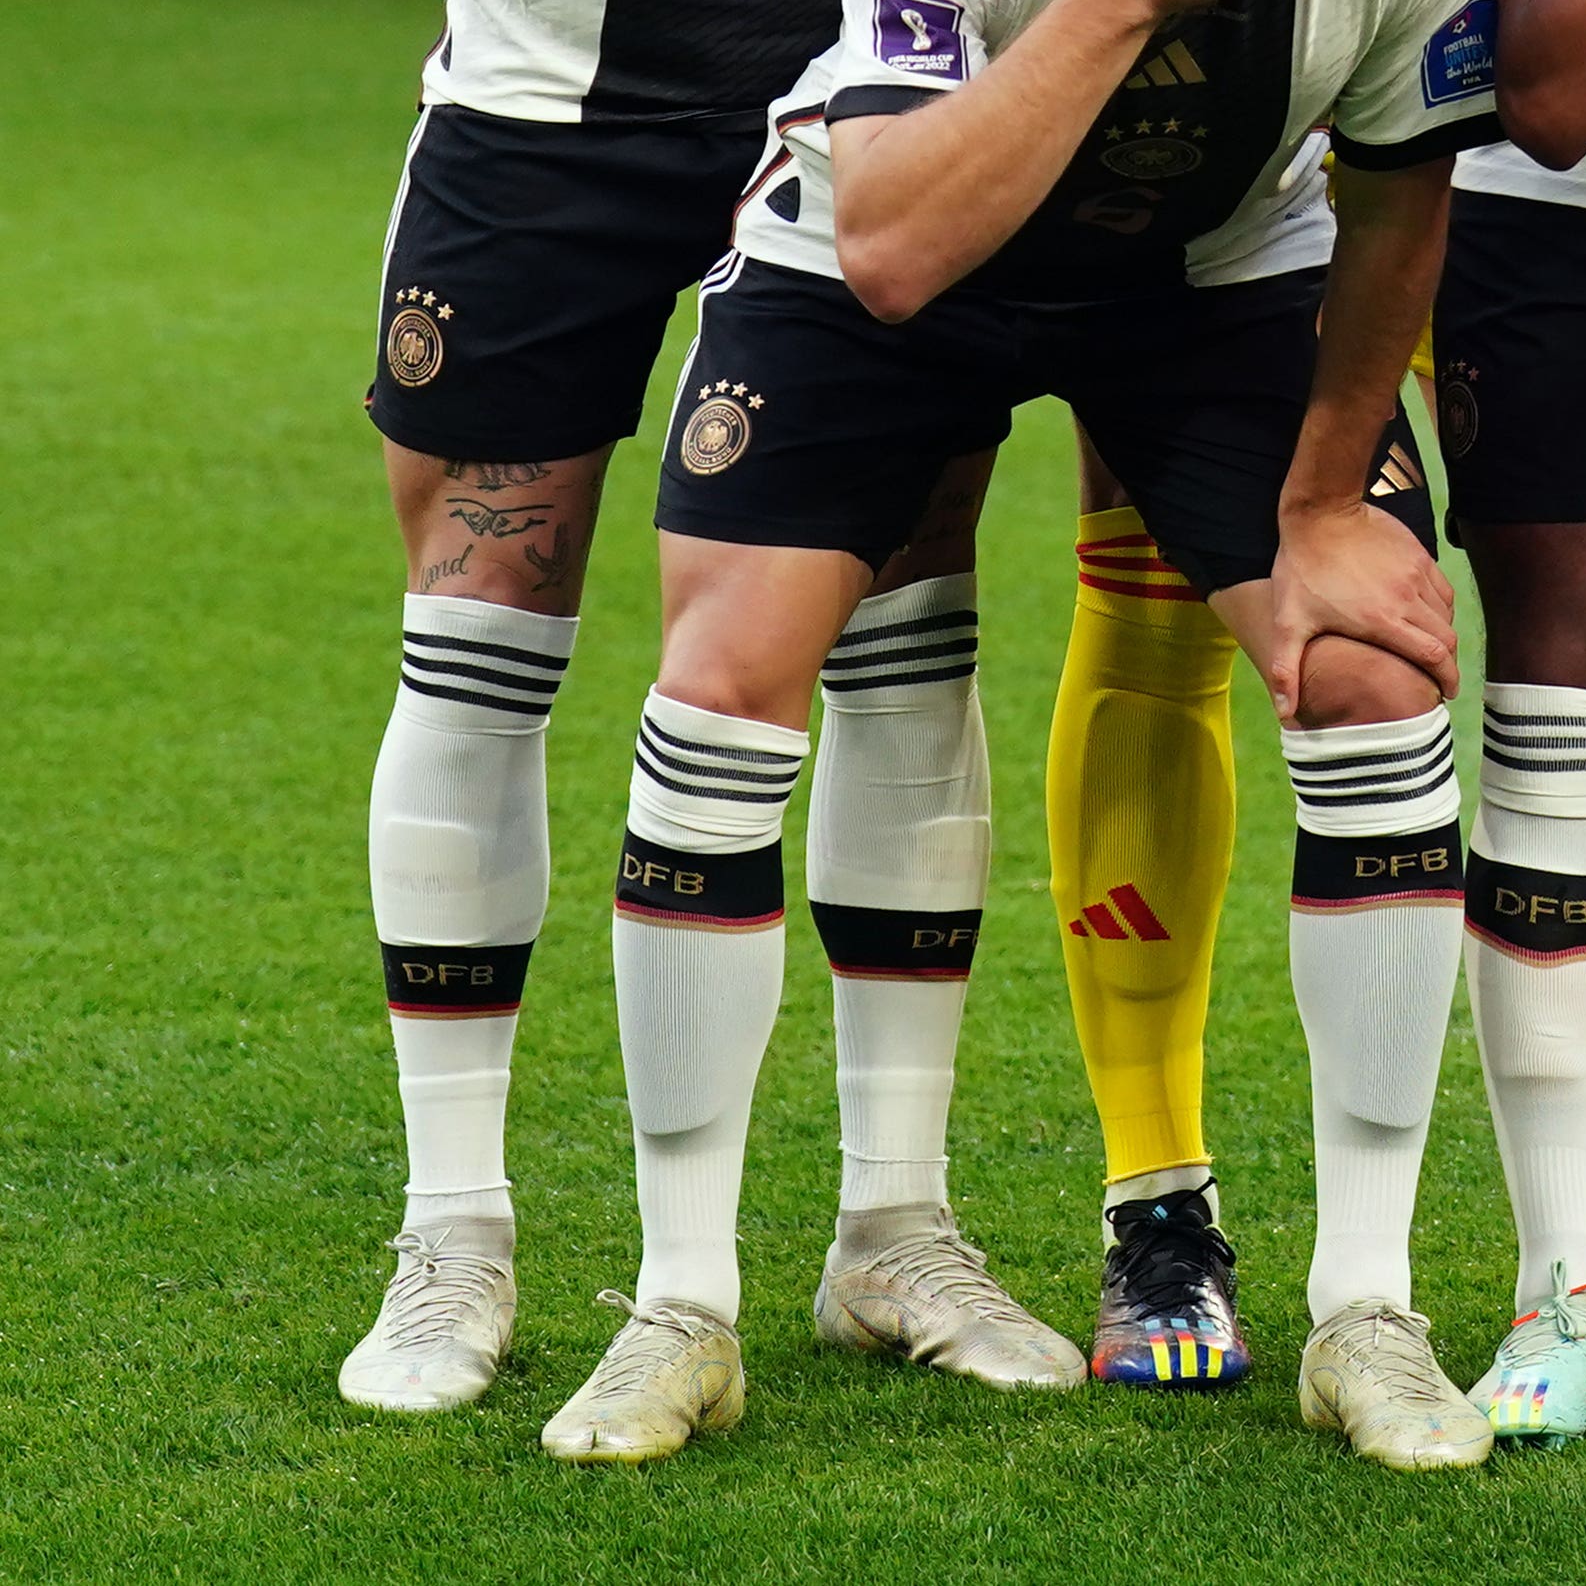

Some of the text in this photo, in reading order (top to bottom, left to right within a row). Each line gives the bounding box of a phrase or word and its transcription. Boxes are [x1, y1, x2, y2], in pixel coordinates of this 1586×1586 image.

[1444, 34, 1484, 55] FOOTBALL
[1444, 42, 1488, 67] UNITES
[889, 54, 954, 64] FIFA WORLD CUP
[1444, 58, 1493, 80] the World
[1462, 74, 1481, 86] FIFA
[623, 852, 704, 895] DFB
[1355, 847, 1448, 878] DFB
[402, 962, 494, 986] DFB
